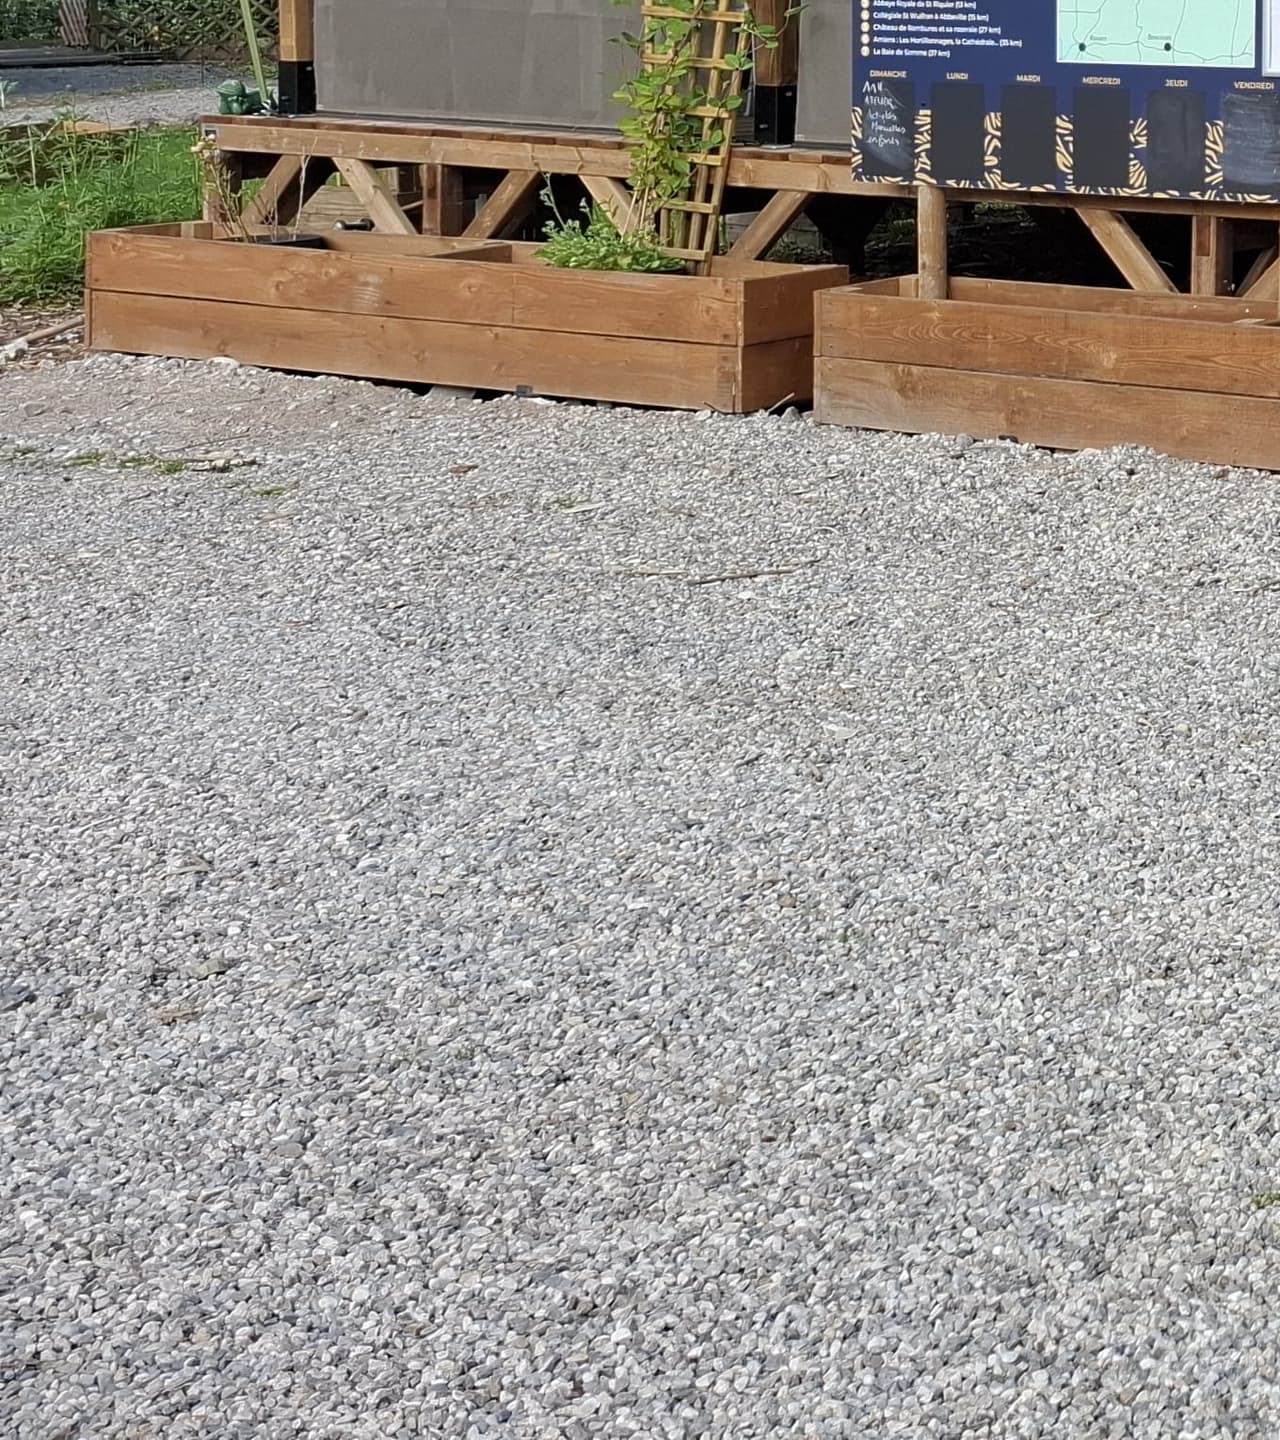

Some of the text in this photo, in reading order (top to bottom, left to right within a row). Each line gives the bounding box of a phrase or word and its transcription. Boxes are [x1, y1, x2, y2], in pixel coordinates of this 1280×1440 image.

[869, 70, 907, 78] DIMANCHE
[946, 72, 969, 80] LUNDI
[1016, 74, 1040, 83] MARDI
[1082, 76, 1121, 85] MERCREDI
[1164, 79, 1188, 88] JEUDI
[1233, 81, 1275, 90] VENDREDI
